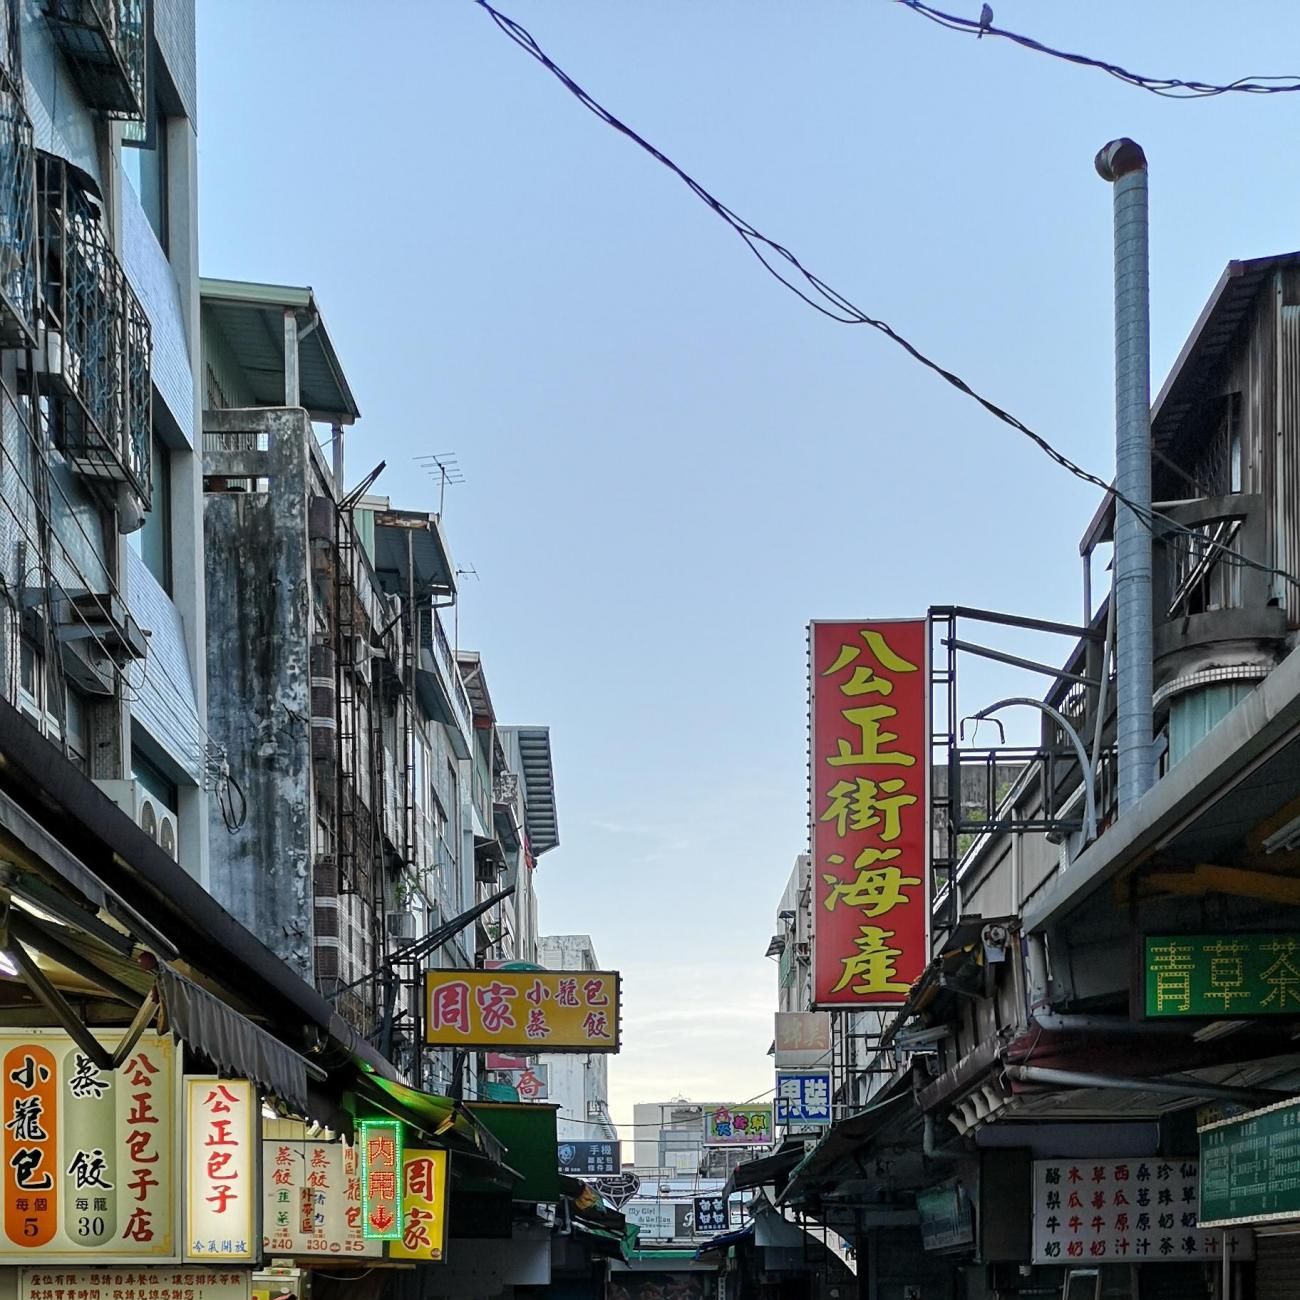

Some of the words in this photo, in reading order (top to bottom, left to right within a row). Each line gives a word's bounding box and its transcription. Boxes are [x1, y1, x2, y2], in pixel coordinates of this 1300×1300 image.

[820, 630, 921, 995] 公正街海產
[527, 980, 608, 1006] 小籠包
[1151, 939, 1300, 1011] 青草茶
[433, 982, 517, 1033] 周家
[527, 1010, 610, 1038] 蒸餃
[7, 1056, 53, 1189] 小籠包
[68, 1054, 113, 1189] 蒸餃
[780, 1078, 827, 1116] 男裝
[122, 1053, 160, 1242] 公正包子店
[203, 1085, 240, 1213] 公正包子
[272, 1146, 295, 1186] 蒸餃
[308, 1149, 331, 1188] 蒸餃
[16, 1198, 48, 1212] 每個
[301, 1188, 313, 1232] 外帶區
[343, 1153, 362, 1228] 籠包
[403, 1159, 433, 1250] 周家
[1045, 1167, 1061, 1257] 酪梨牛奶
[1067, 1166, 1083, 1257] 木瓜牛奶
[1090, 1166, 1106, 1257] 草莓牛奶
[1113, 1165, 1129, 1255] 西瓜原汁
[1157, 1163, 1174, 1255] 珍珠奶茶
[23, 1217, 39, 1237] 5
[78, 1216, 105, 1237] 30
[192, 1240, 248, 1253] 冷氣開放
[277, 1240, 293, 1250] 40
[312, 1240, 328, 1250] 30
[353, 1241, 365, 1252] 5
